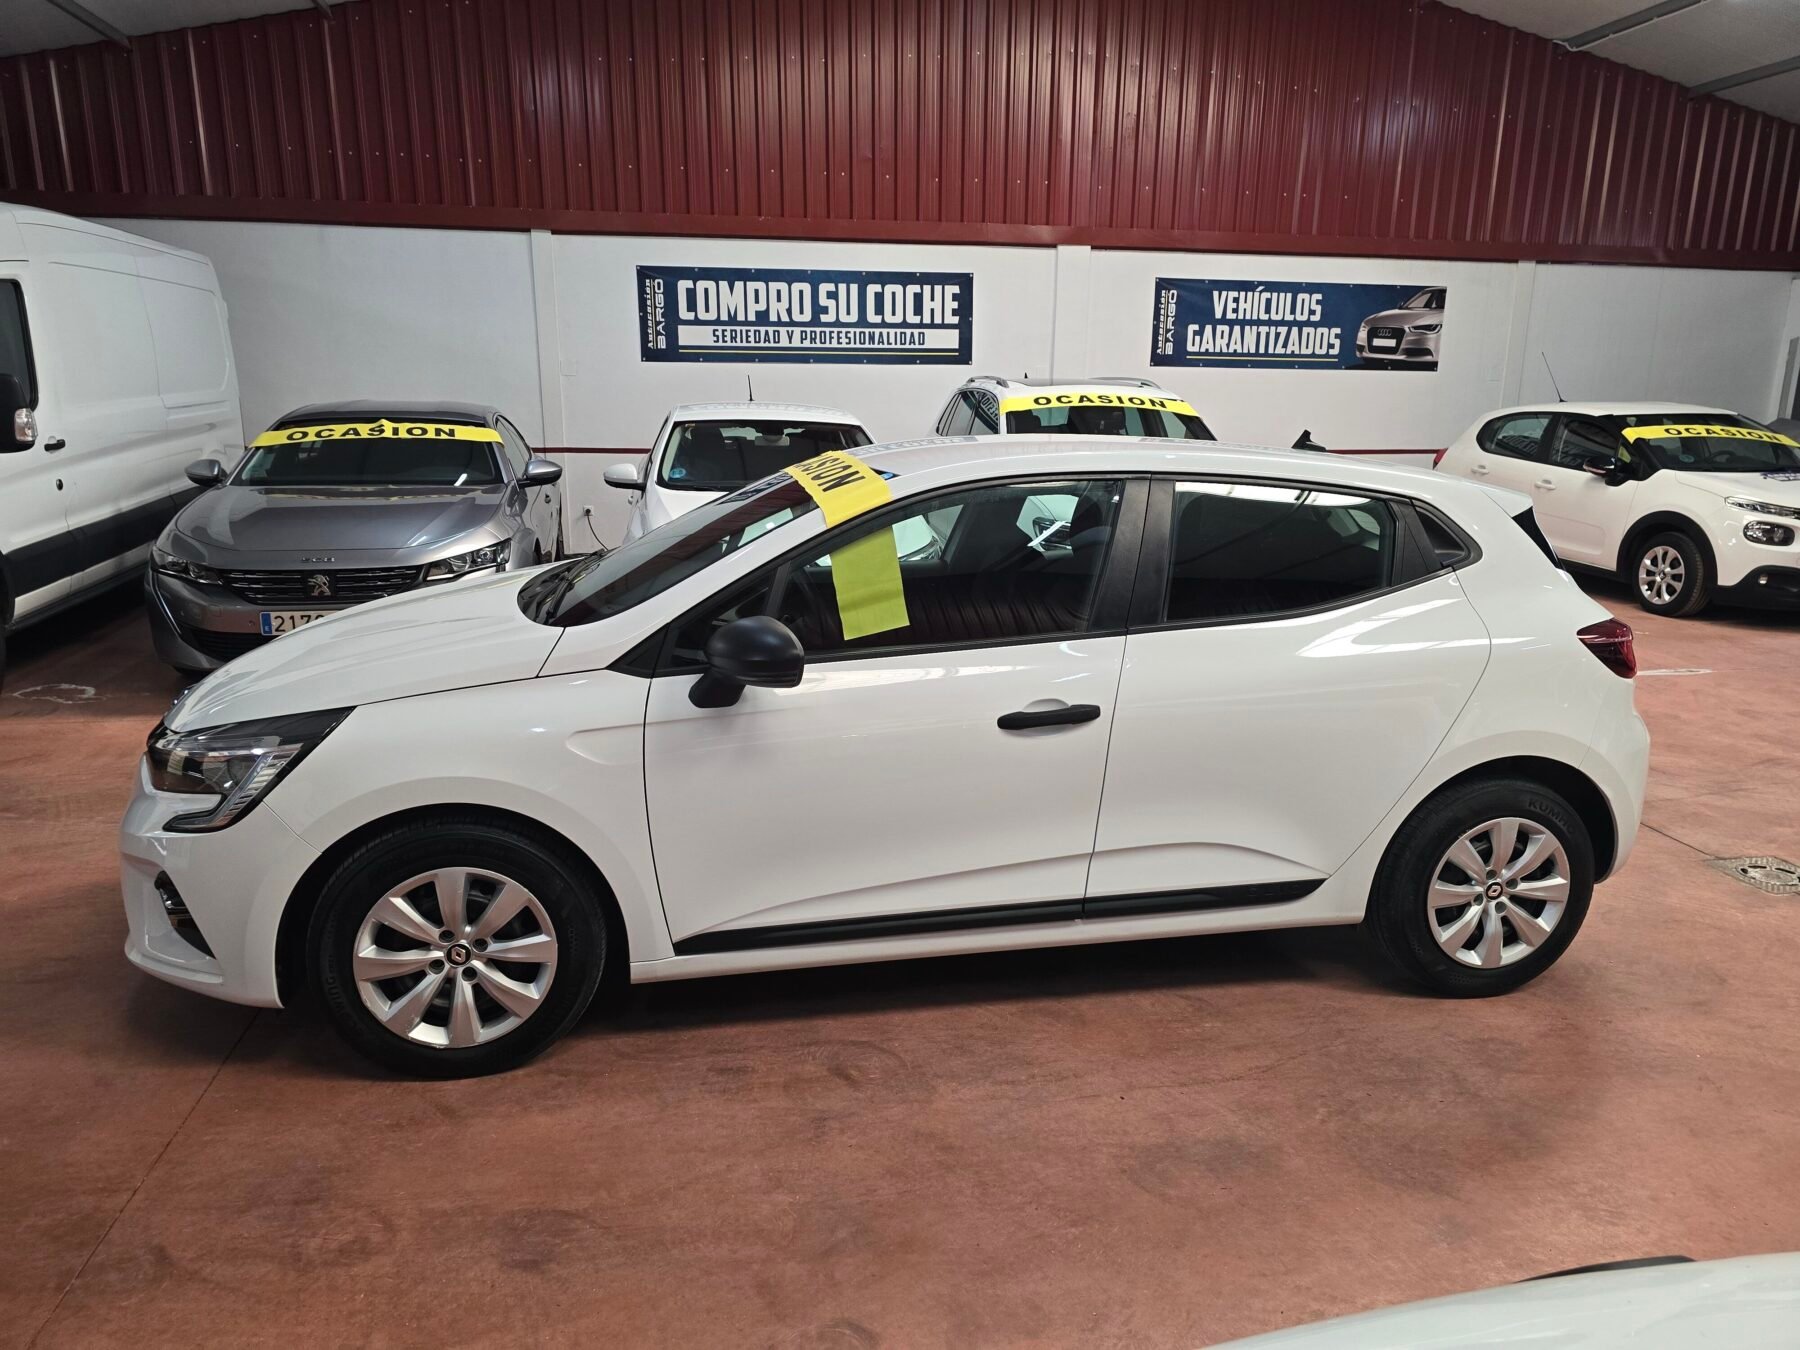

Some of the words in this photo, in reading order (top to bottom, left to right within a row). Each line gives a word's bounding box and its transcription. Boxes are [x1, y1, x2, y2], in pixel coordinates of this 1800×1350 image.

[654, 278, 667, 350] BARGO
[677, 279, 812, 322] COMPRO
[818, 282, 859, 323] SU
[866, 283, 960, 325] COCHE
[1212, 286, 1323, 321] VEHÍCULOS
[1165, 289, 1178, 355] BARGO
[712, 328, 781, 345] SERIEDAD
[786, 329, 795, 345] Y
[800, 329, 927, 347] PROFESIONALIDAD
[1186, 323, 1342, 356] GARANTIZADOS
[1033, 394, 1168, 409] OCASION
[286, 423, 457, 441] OCASION
[1664, 427, 1782, 443] OCASION
[274, 614, 326, 633] 217
